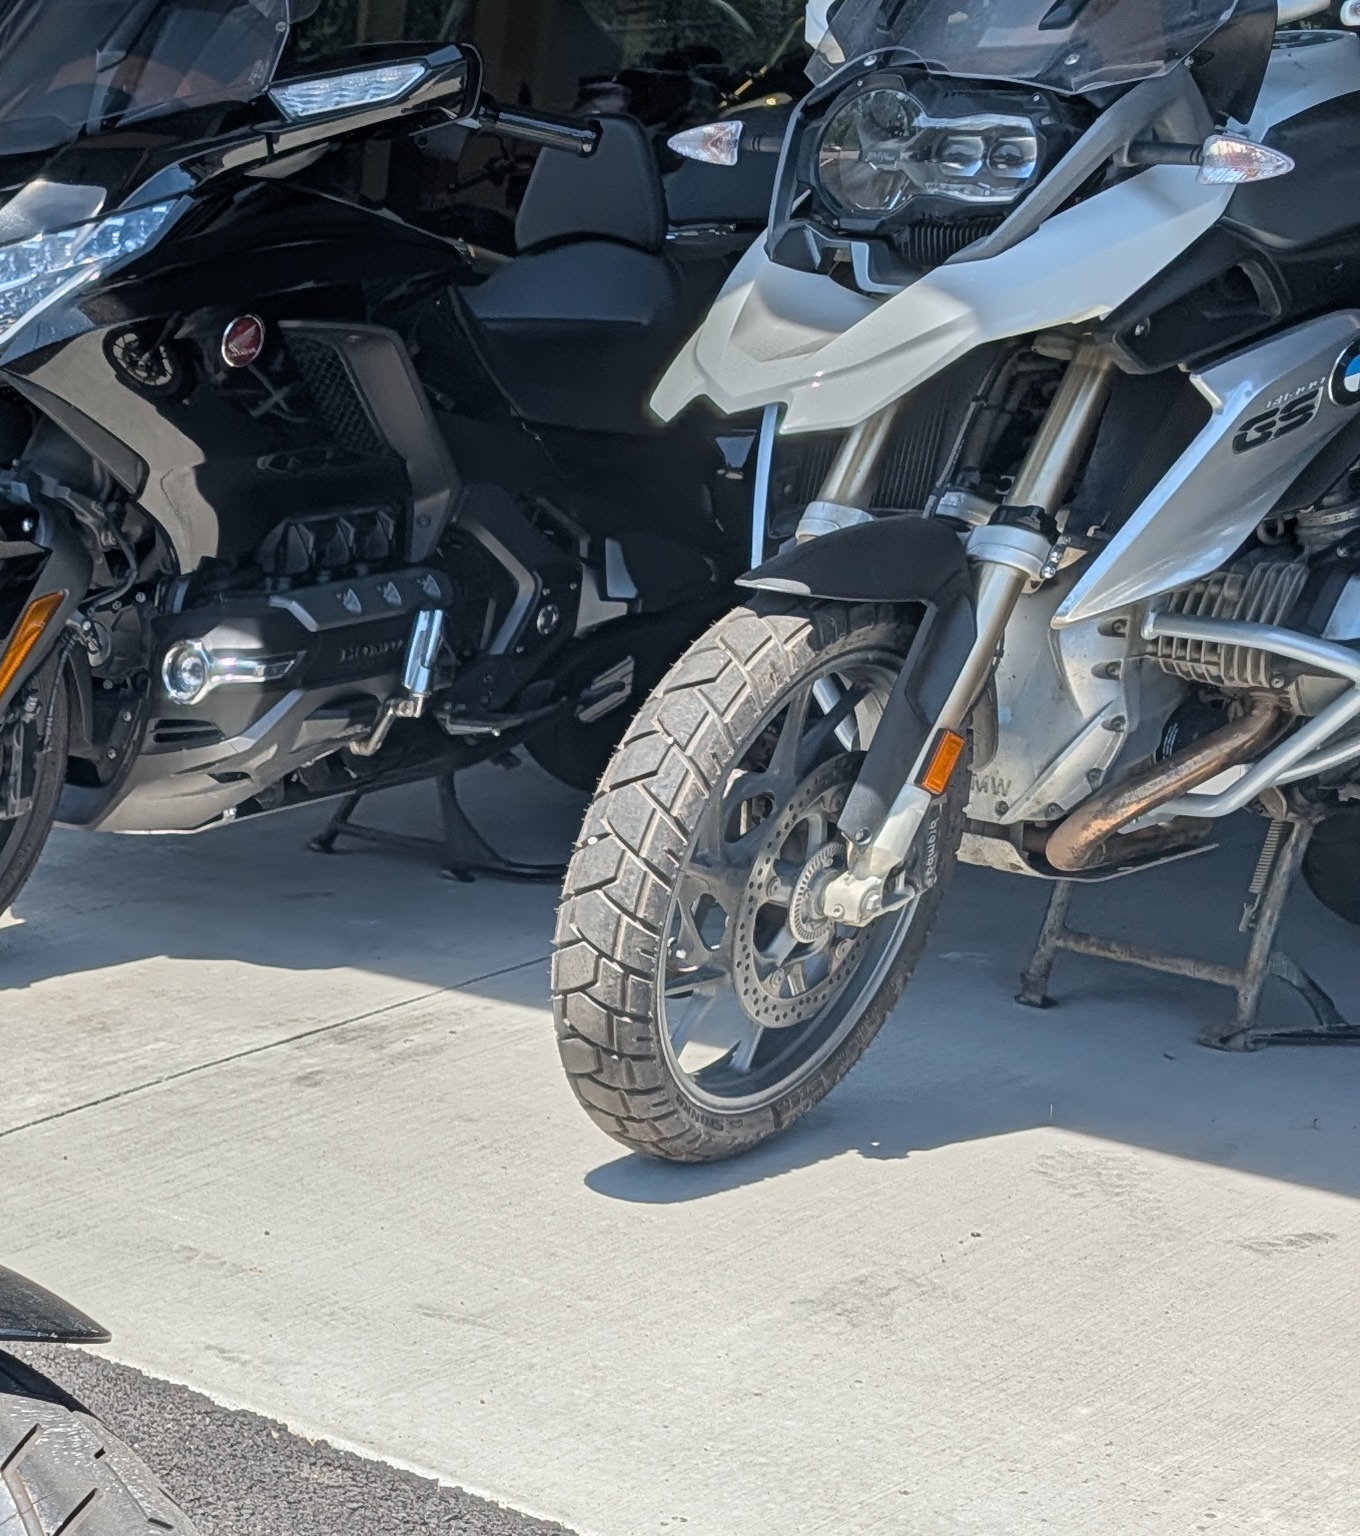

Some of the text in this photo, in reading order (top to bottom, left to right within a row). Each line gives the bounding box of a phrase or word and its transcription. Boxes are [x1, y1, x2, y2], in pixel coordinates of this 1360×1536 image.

[1232, 388, 1321, 454] GS
[971, 774, 1012, 797] MW
[925, 816, 940, 876] brembo
